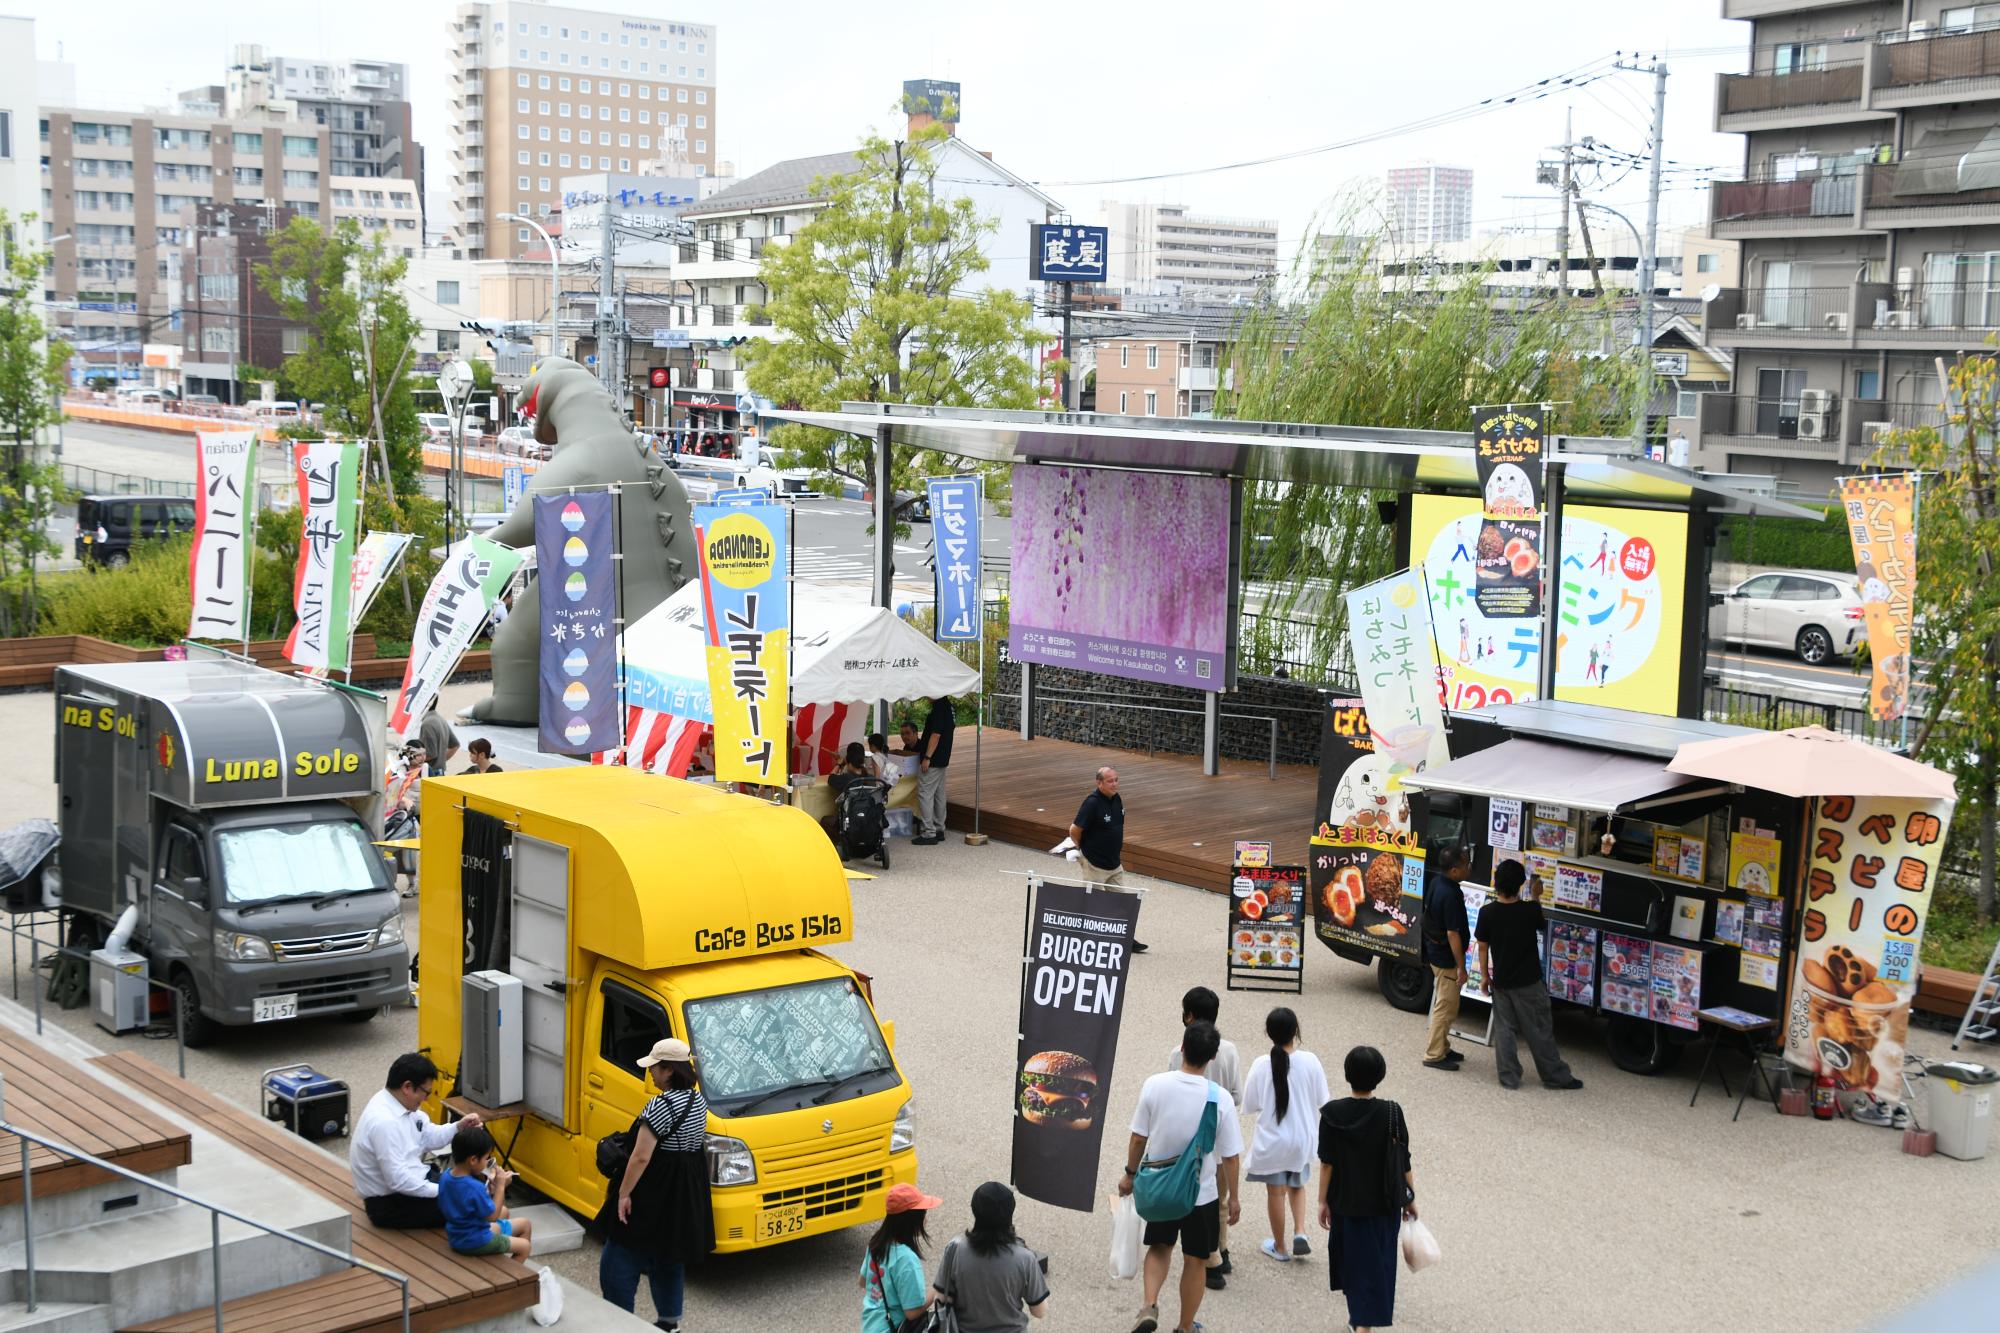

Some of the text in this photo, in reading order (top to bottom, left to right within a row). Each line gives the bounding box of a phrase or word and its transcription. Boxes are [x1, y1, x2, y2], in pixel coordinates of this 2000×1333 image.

[1043, 239, 1103, 268] 藍屋
[1626, 544, 1650, 559] 入場
[1623, 557, 1648, 574] 無料
[1023, 633, 1045, 643] ようこそ
[1088, 653, 1167, 673] Welcome to Kasukabe City
[205, 749, 359, 783] Luna Sole
[1405, 865, 1422, 878] 350
[1804, 796, 1855, 942] カステラ
[1848, 814, 1896, 932] ベビー
[1884, 811, 1942, 936] 卵屋の
[1408, 878, 1418, 891] 円
[1043, 912, 1128, 935] DELICIOUS HOMEMADE
[695, 928, 746, 954] Cafe
[757, 921, 795, 948] Bus
[1038, 932, 1124, 971] BURGER
[1885, 941, 1914, 956] 15個
[1621, 963, 1648, 977] 350円
[1884, 955, 1909, 968] 500
[1887, 968, 1900, 981] 円
[1033, 965, 1118, 1016] OPEN
[262, 1004, 295, 1019] 21-57
[767, 1215, 803, 1237] 58-25
